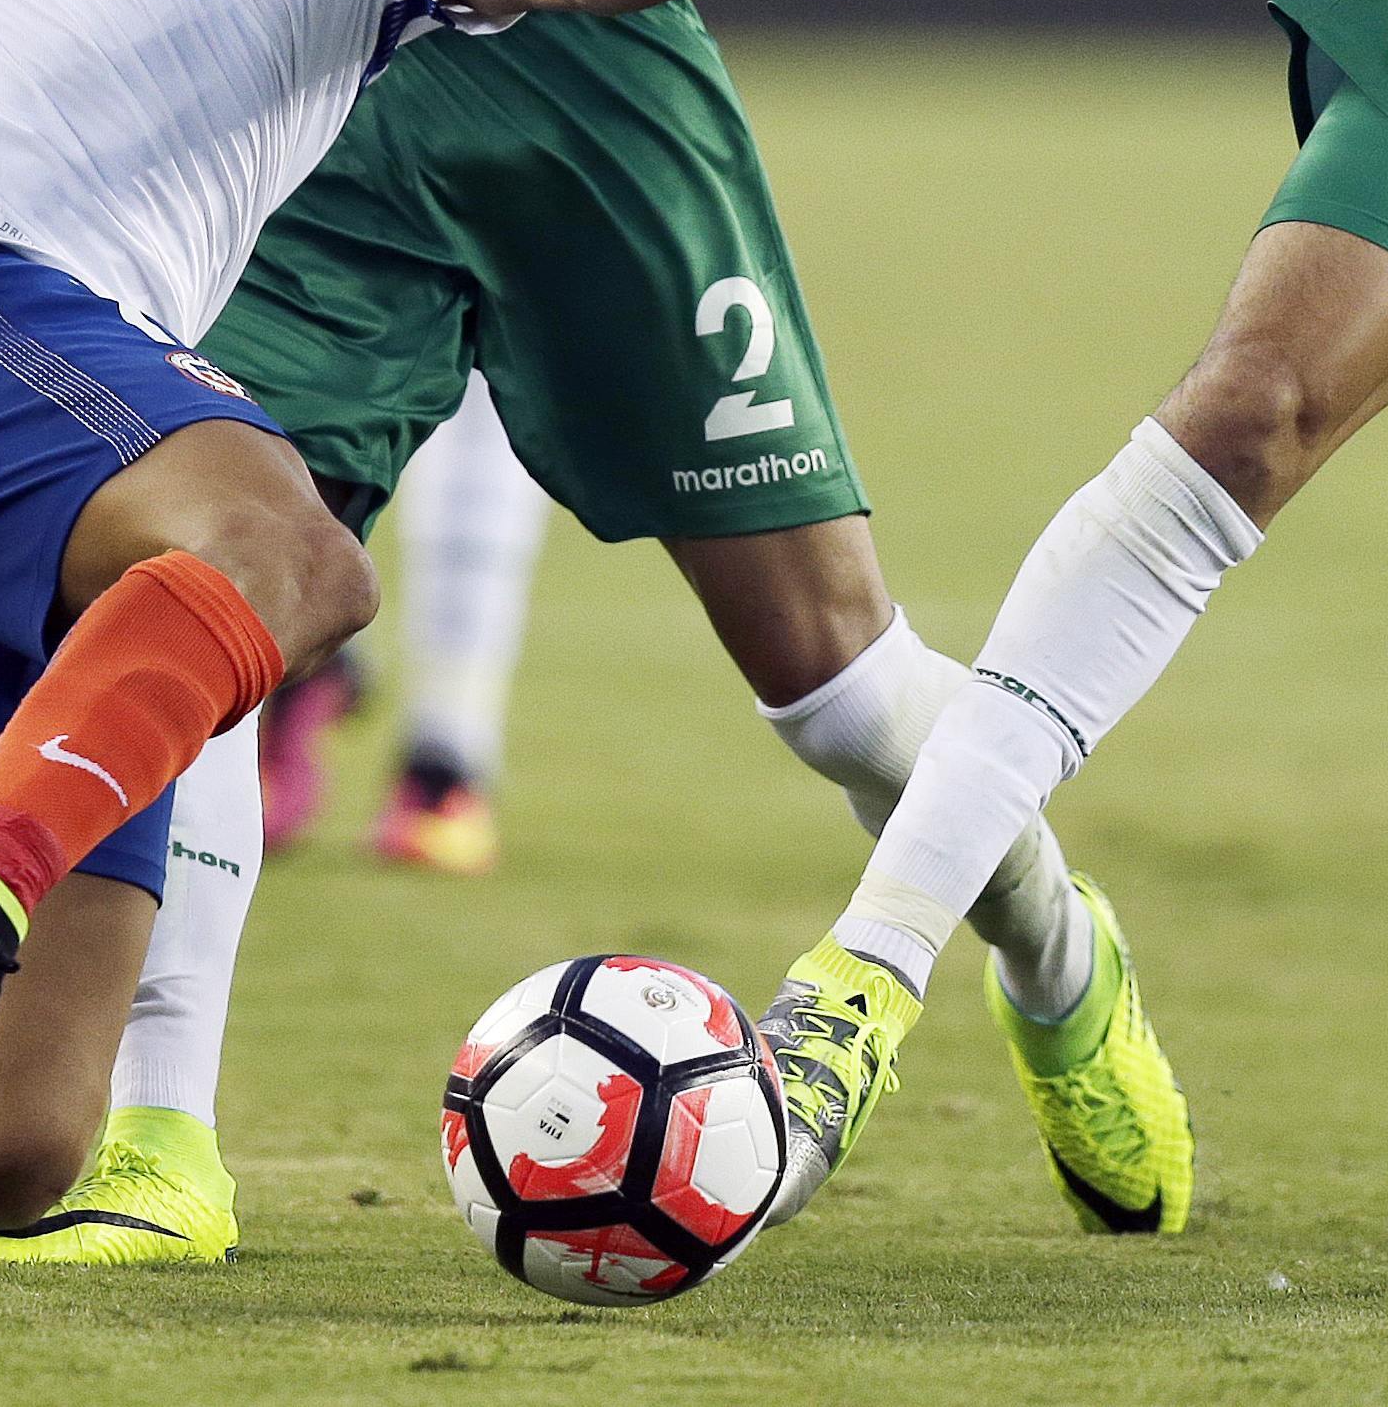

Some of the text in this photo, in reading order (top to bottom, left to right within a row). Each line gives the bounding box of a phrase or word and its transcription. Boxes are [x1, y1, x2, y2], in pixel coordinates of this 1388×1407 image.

[694, 275, 796, 442] 2
[672, 448, 828, 492] marathon
[168, 840, 240, 878] hon
[539, 1118, 563, 1140] FIFA
